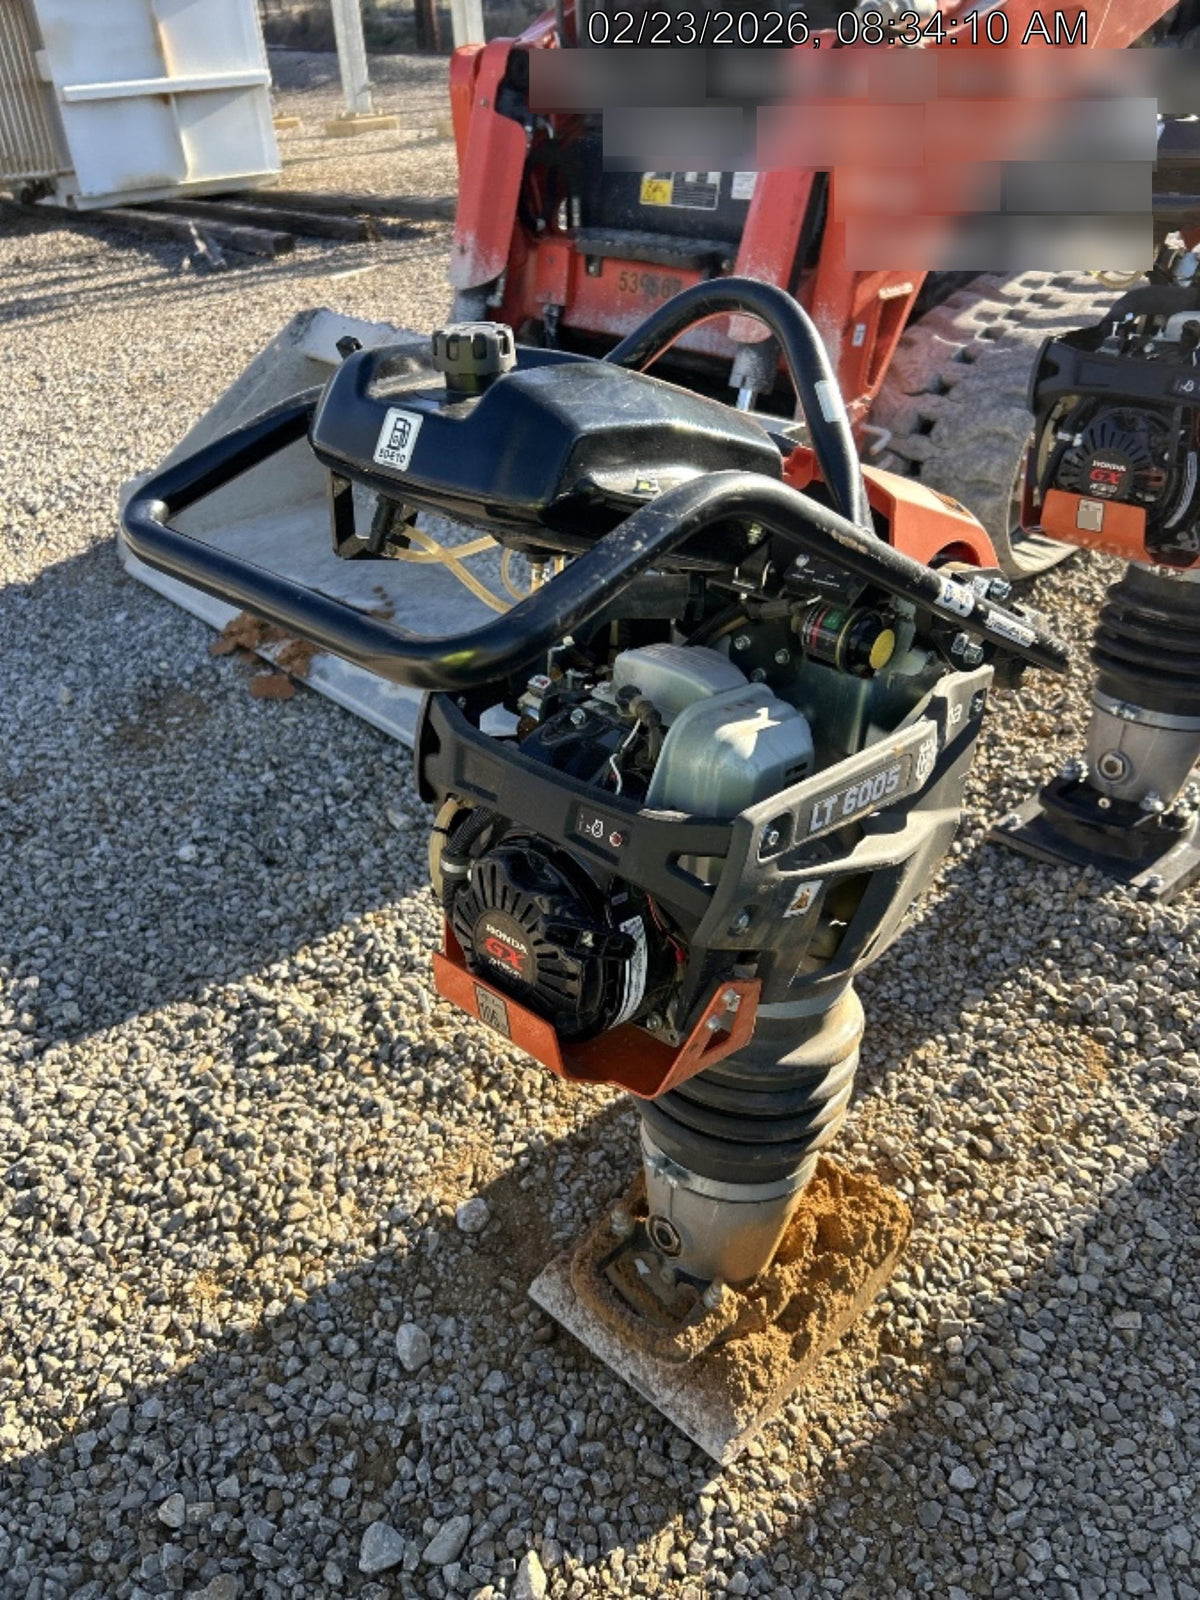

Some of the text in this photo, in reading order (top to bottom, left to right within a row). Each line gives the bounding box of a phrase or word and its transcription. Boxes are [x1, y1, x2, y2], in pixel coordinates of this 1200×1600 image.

[1089, 469, 1124, 485] GX
[809, 763, 901, 833] LT 6005
[484, 936, 527, 972] GX
[486, 924, 529, 956] HONDA
